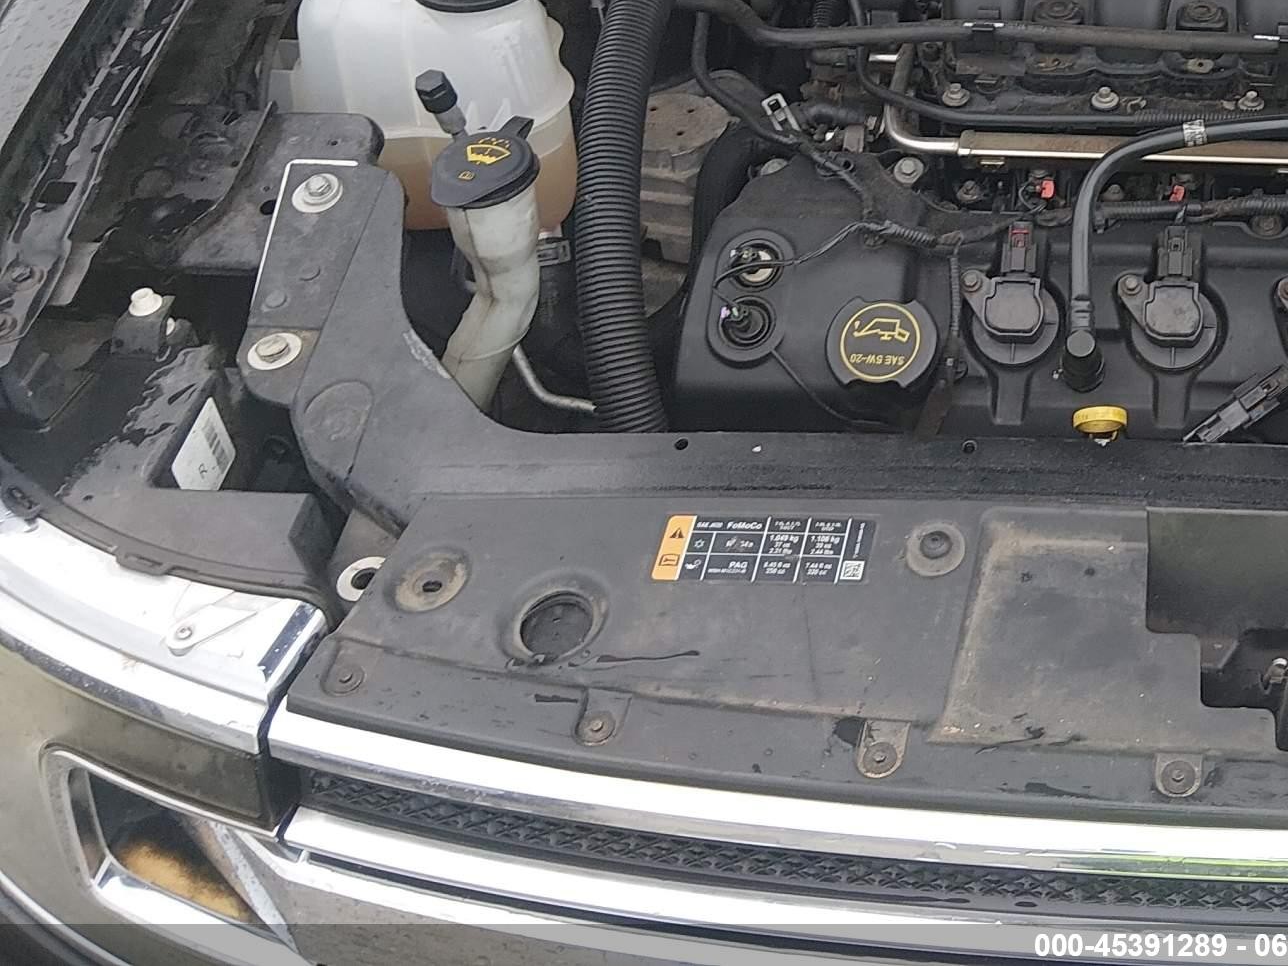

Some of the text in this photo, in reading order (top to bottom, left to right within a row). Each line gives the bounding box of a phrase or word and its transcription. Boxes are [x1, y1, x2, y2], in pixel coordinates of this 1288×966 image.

[850, 353, 905, 365] SAE 5W-20
[726, 521, 763, 530] FoMoCo
[789, 535, 799, 544] kg
[830, 536, 840, 544] kg
[728, 561, 748, 569] PAG
